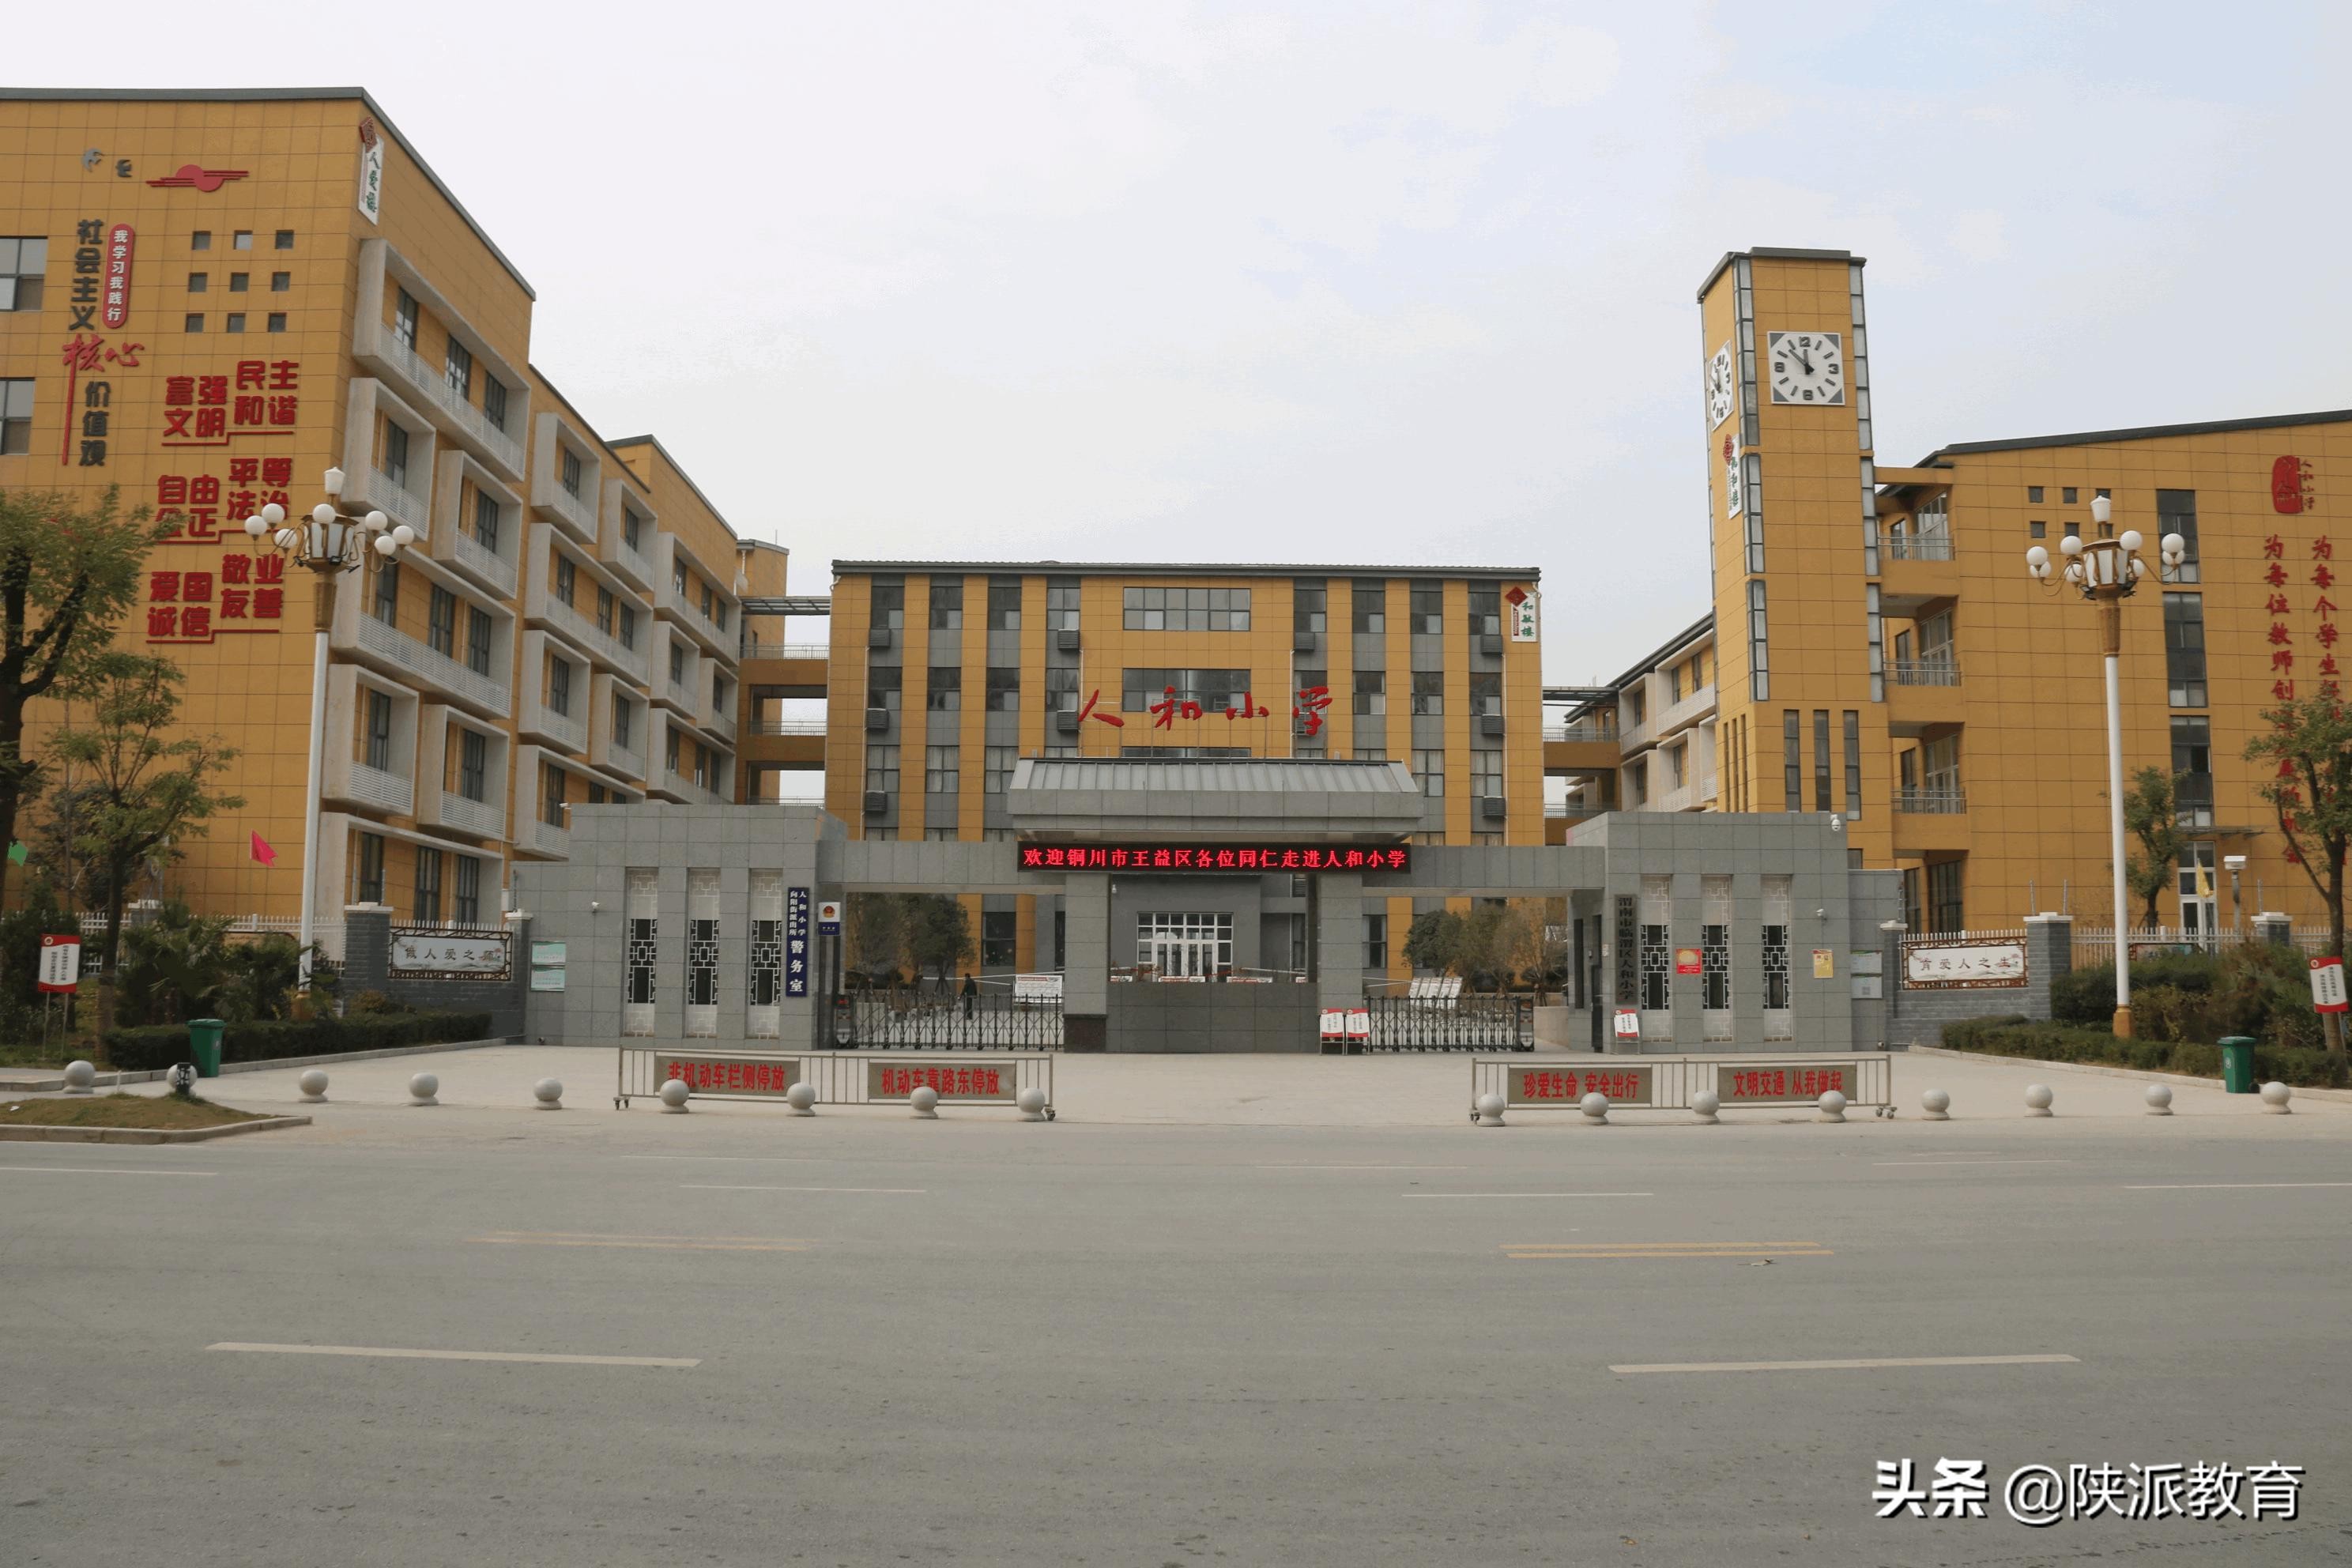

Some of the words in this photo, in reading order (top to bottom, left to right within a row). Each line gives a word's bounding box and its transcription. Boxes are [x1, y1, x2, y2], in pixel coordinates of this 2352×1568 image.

[69, 219, 104, 330] 社会主义
[107, 229, 128, 322] 我学习我践行
[62, 333, 145, 372] 核心
[236, 360, 300, 390] 民主
[1828, 363, 1839, 375] 3
[165, 375, 228, 405] 富强
[78, 381, 111, 466] 价值观
[163, 407, 226, 437] 文明
[233, 395, 298, 425] 和谐
[228, 457, 292, 488] 平等
[157, 474, 220, 504] 自由
[221, 553, 285, 585] 敬业
[149, 571, 213, 602] 爱国
[220, 588, 285, 619] 友善
[147, 606, 211, 637] 诚信
[1077, 684, 1333, 737] 人和小学
[1023, 847, 1407, 869] 欢迎铜川市王益区各位同仁走进人和小学
[790, 940, 805, 993] 警务室
[668, 1061, 786, 1091] 非机动车栏侧停放
[881, 1067, 1000, 1095] 机动车靠路东停放
[1523, 1071, 1577, 1099] 珍爱生命
[1584, 1072, 1638, 1099] 安全出行
[1732, 1070, 1786, 1097] 文明交通
[1791, 1068, 1843, 1096] 从我做起
